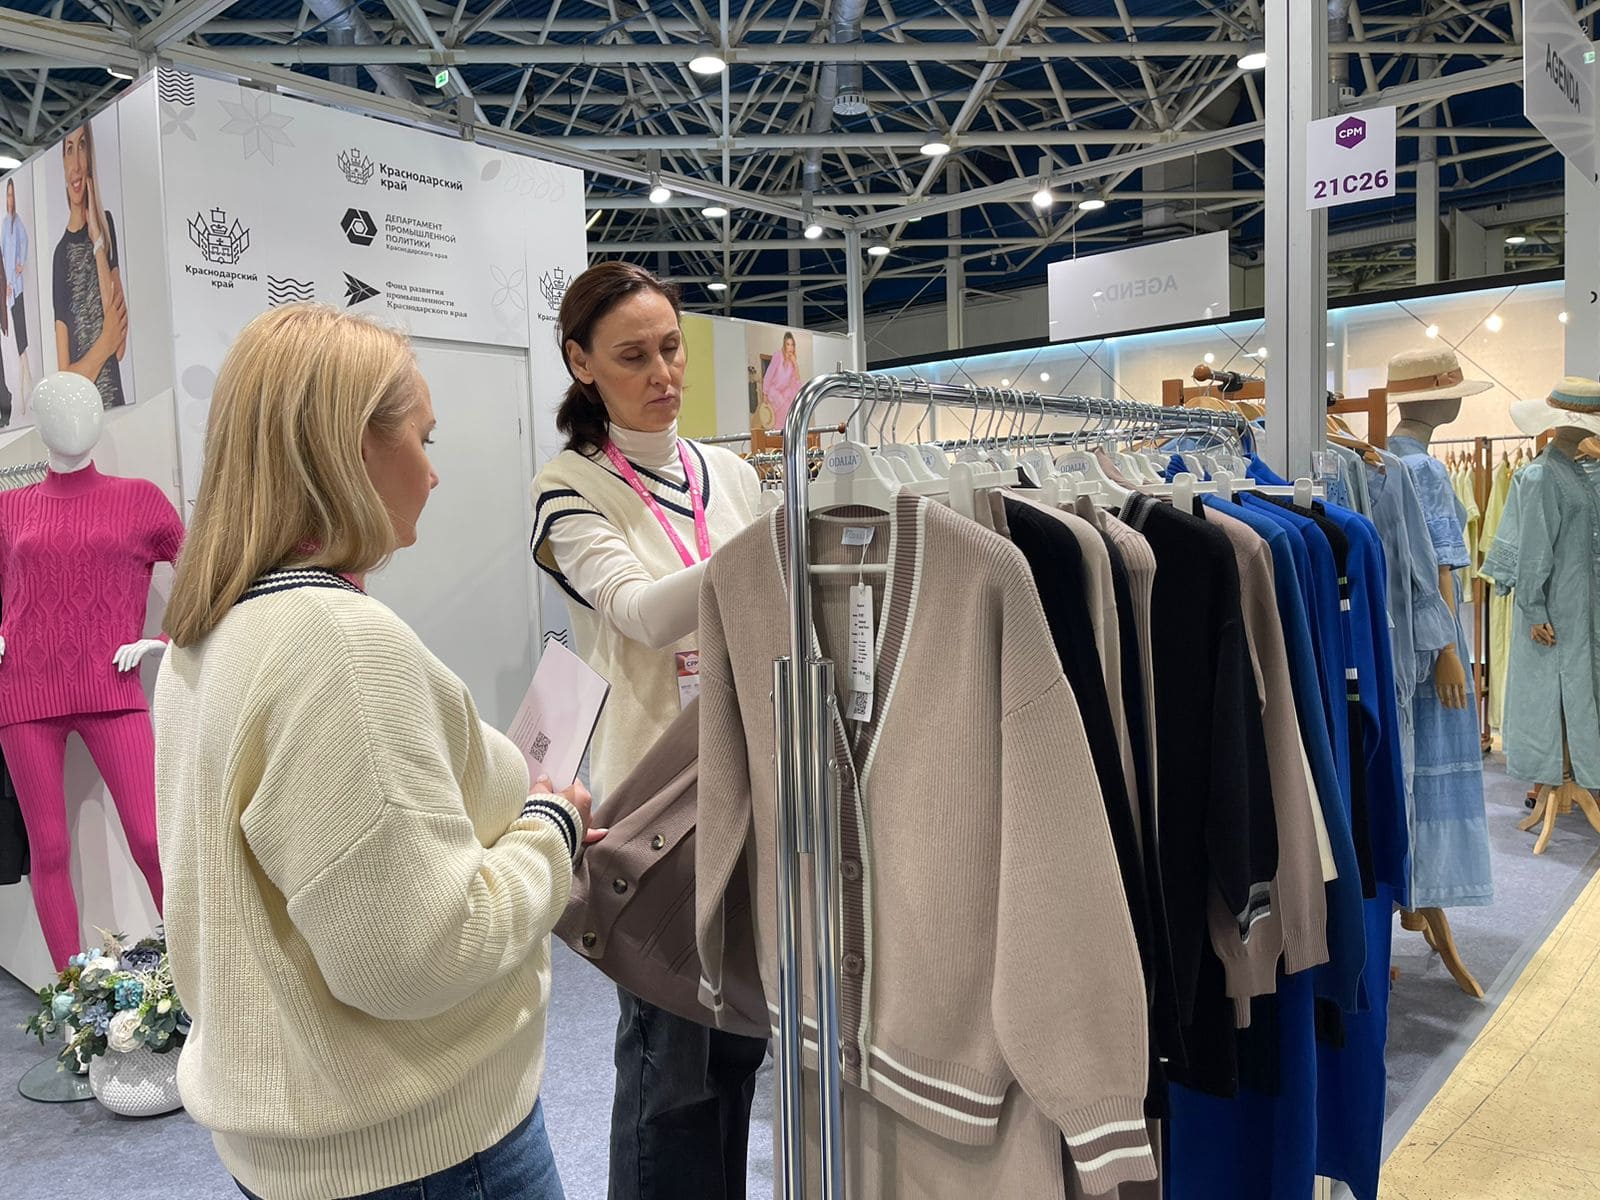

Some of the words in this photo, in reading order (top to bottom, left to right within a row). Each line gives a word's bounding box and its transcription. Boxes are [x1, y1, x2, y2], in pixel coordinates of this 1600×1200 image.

[1545, 42, 1581, 114] AGENDA
[1338, 126, 1363, 139] CPM
[379, 162, 463, 191] Краснодарский
[380, 178, 408, 192] край
[1313, 169, 1389, 199] 21C26
[385, 214, 443, 231] ДЕПАРТАМЕНТ
[385, 223, 456, 244] ПРОМЫШЛЕННОЙ
[385, 234, 431, 249] ПОЛИТИКИ
[184, 264, 258, 281] Краснодарский
[211, 279, 235, 289] край
[385, 281, 408, 291] Фонд
[409, 285, 445, 296] развития
[386, 292, 455, 307] промышленности
[386, 300, 449, 315] Краснодарского
[449, 310, 468, 319] края
